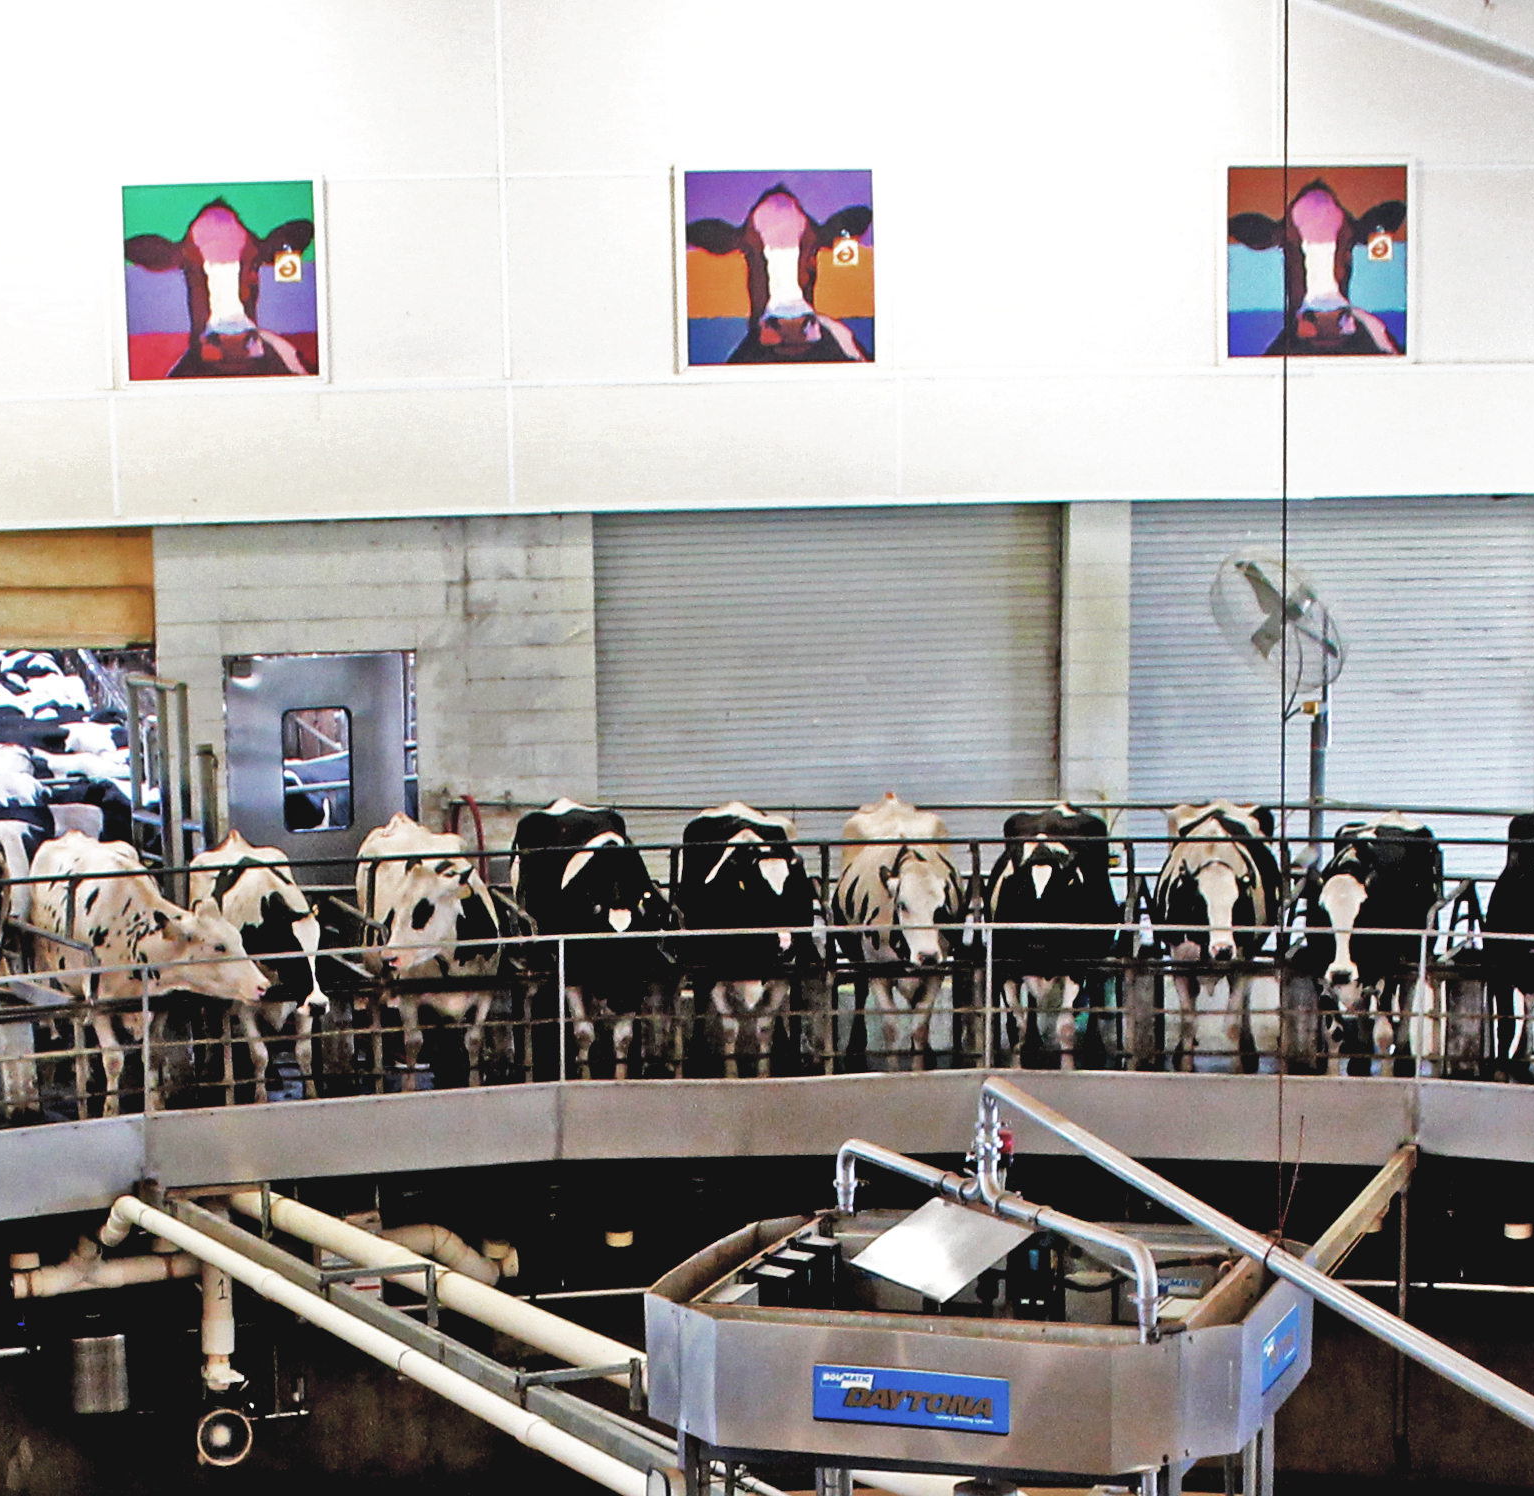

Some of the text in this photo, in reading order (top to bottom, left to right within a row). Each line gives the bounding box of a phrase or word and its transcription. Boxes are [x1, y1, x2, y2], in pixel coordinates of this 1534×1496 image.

[217, 1278, 228, 1300] 1
[822, 1373, 871, 1383] BOUMATIC
[844, 1387, 993, 1419] DAYTONA
